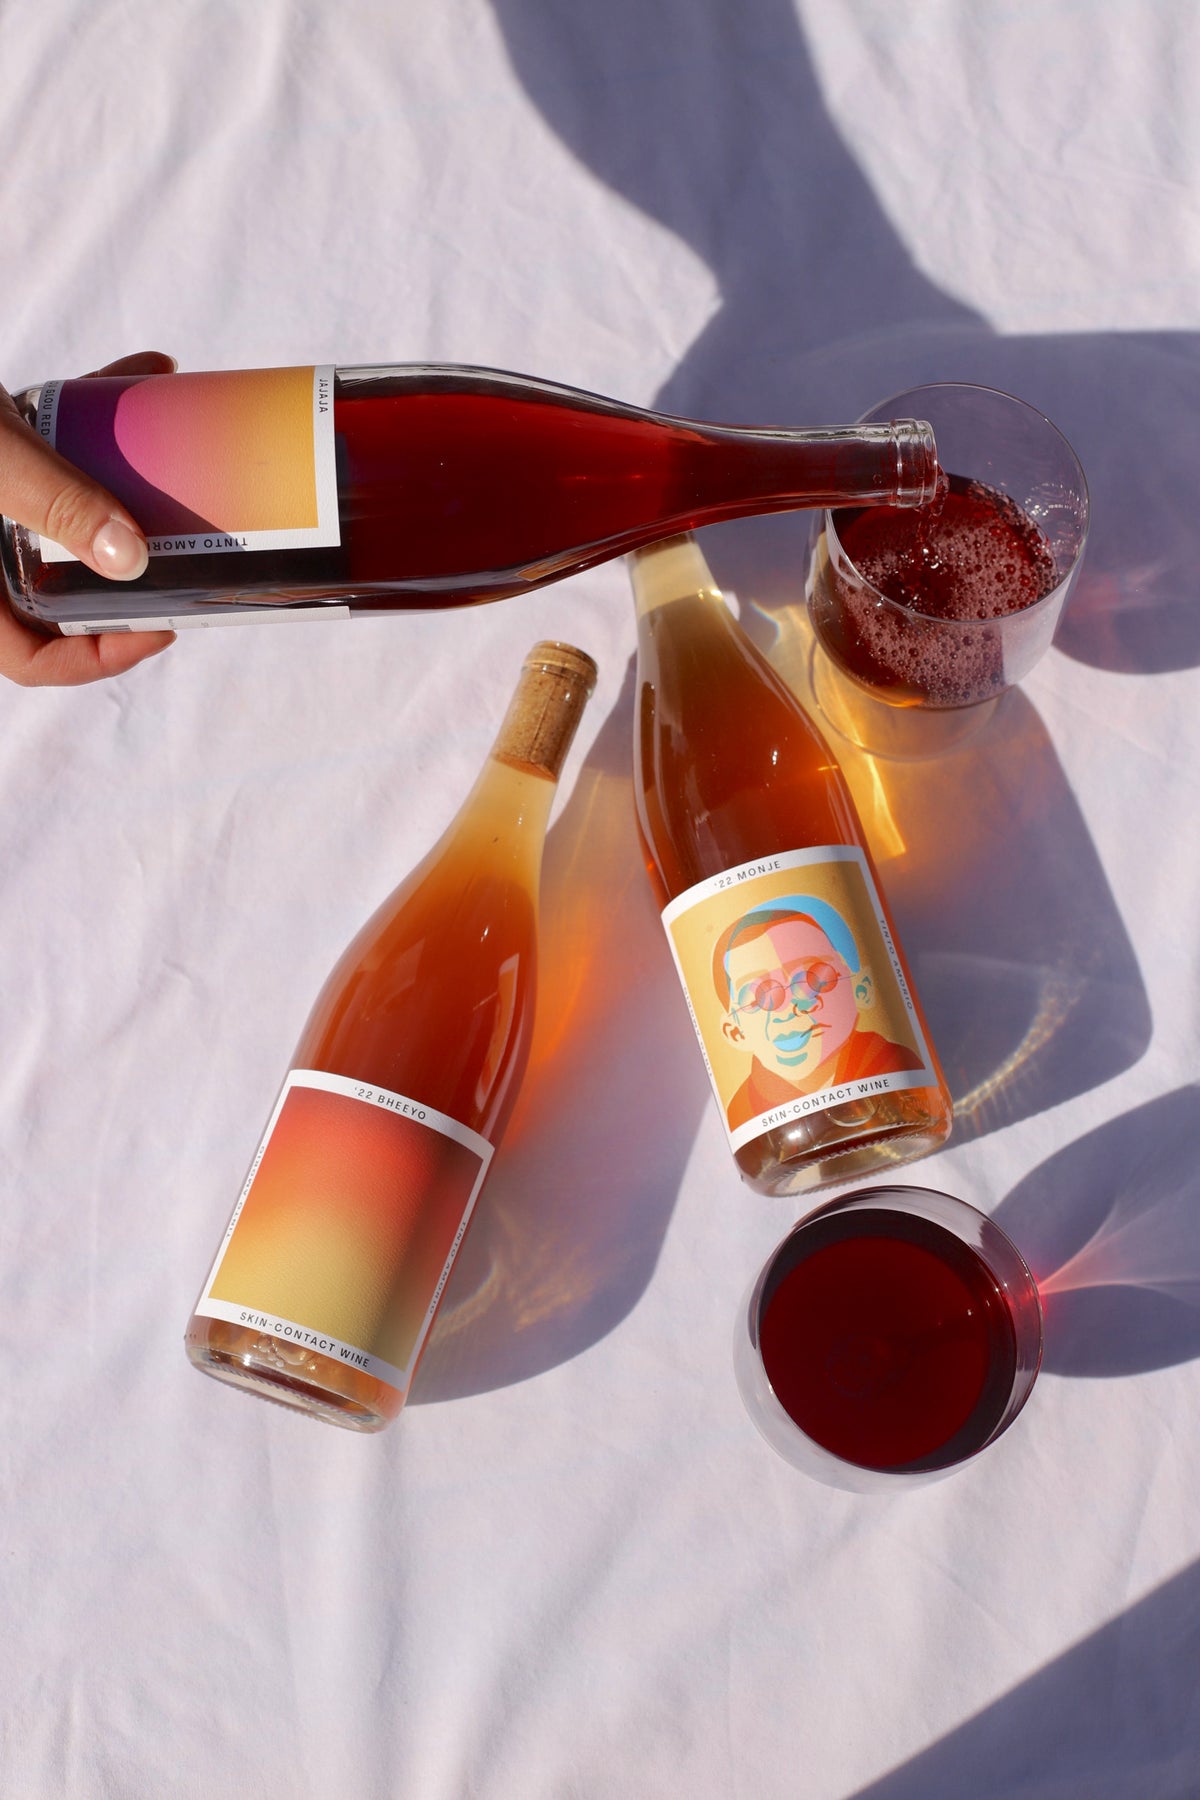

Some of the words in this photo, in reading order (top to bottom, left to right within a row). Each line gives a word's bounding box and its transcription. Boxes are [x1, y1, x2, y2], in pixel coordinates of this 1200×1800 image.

[43, 389, 56, 410] GLOU
[318, 378, 329, 413] JAJAJA
[41, 414, 52, 436] RED
[147, 539, 196, 552] AMORI
[203, 537, 248, 549] TINTO
[713, 876, 733, 889] '22
[736, 860, 781, 881] MONJE
[880, 919, 895, 955] TINTO
[354, 1087, 374, 1101] '22
[377, 1094, 426, 1121] BHEEYO
[761, 1087, 852, 1128] SKIN-CONTACT
[857, 1078, 891, 1094] WINE
[239, 1311, 336, 1352] SKIN-CONTACT
[340, 1347, 370, 1368] WINE
